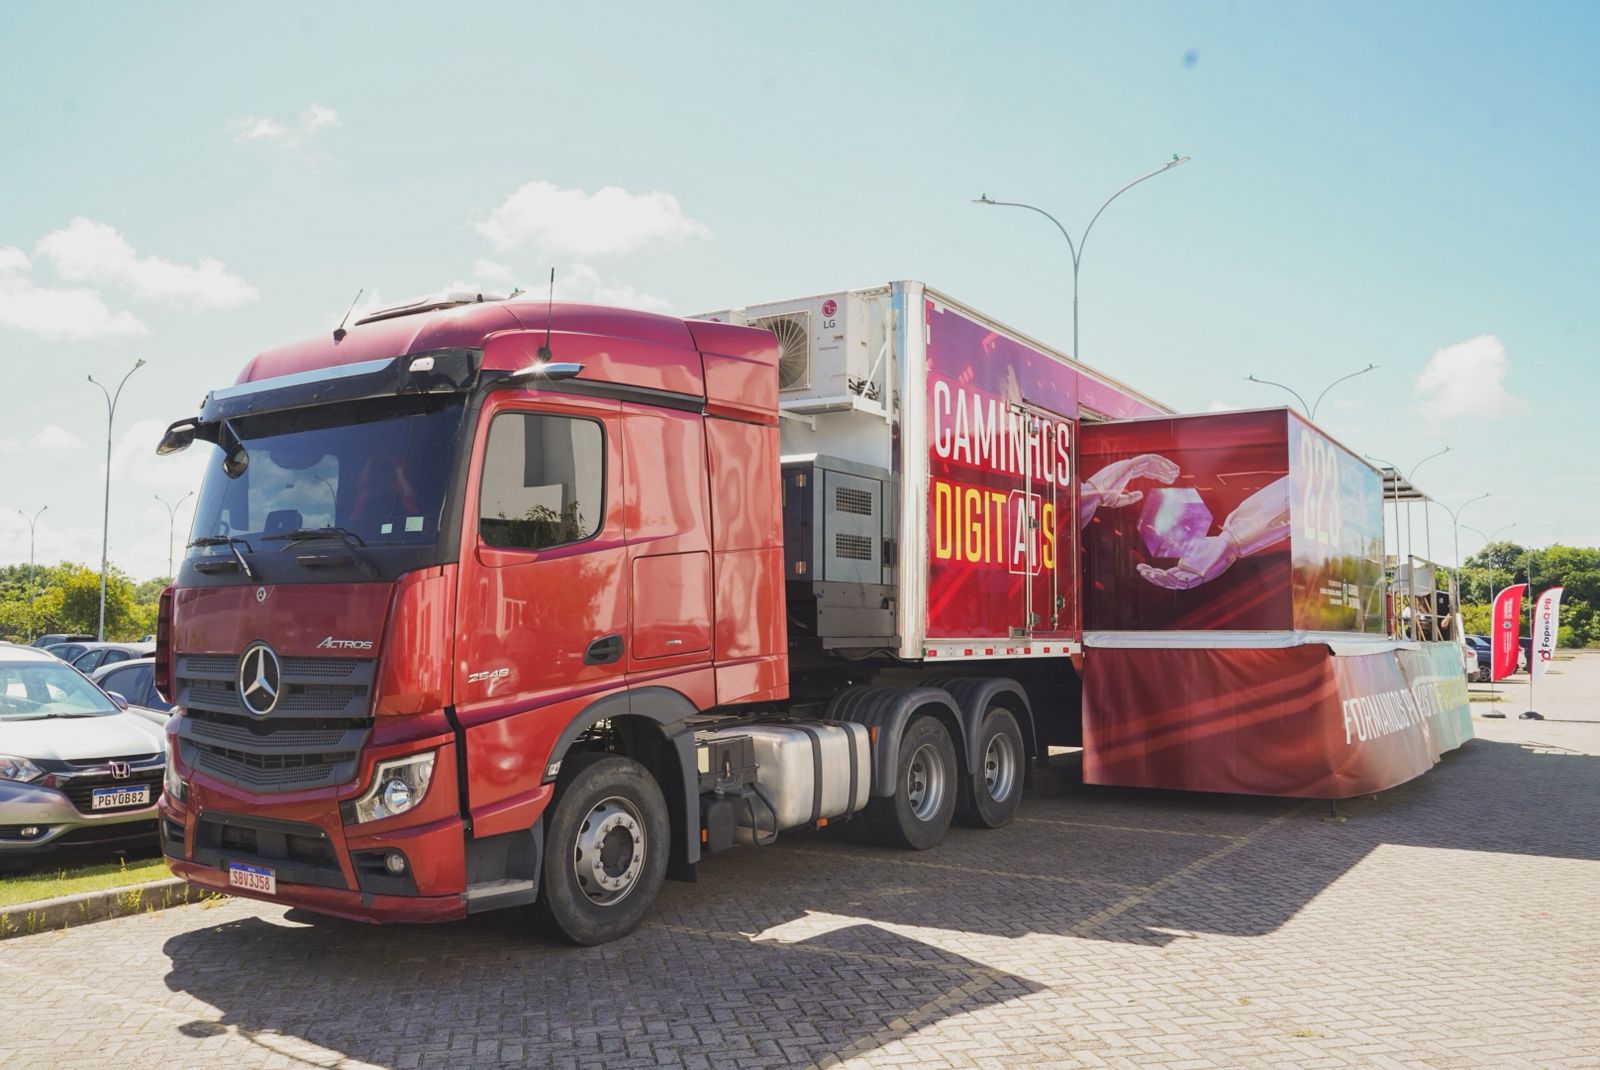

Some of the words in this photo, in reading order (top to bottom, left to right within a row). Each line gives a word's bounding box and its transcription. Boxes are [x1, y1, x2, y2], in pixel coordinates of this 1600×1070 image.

[823, 319, 836, 329] LG
[934, 380, 1070, 487] CAMINHOS
[936, 481, 1056, 570] DIGITAIS
[316, 636, 373, 649] ACTROS
[467, 668, 509, 683] 2548
[233, 870, 270, 891] SBV3J58
